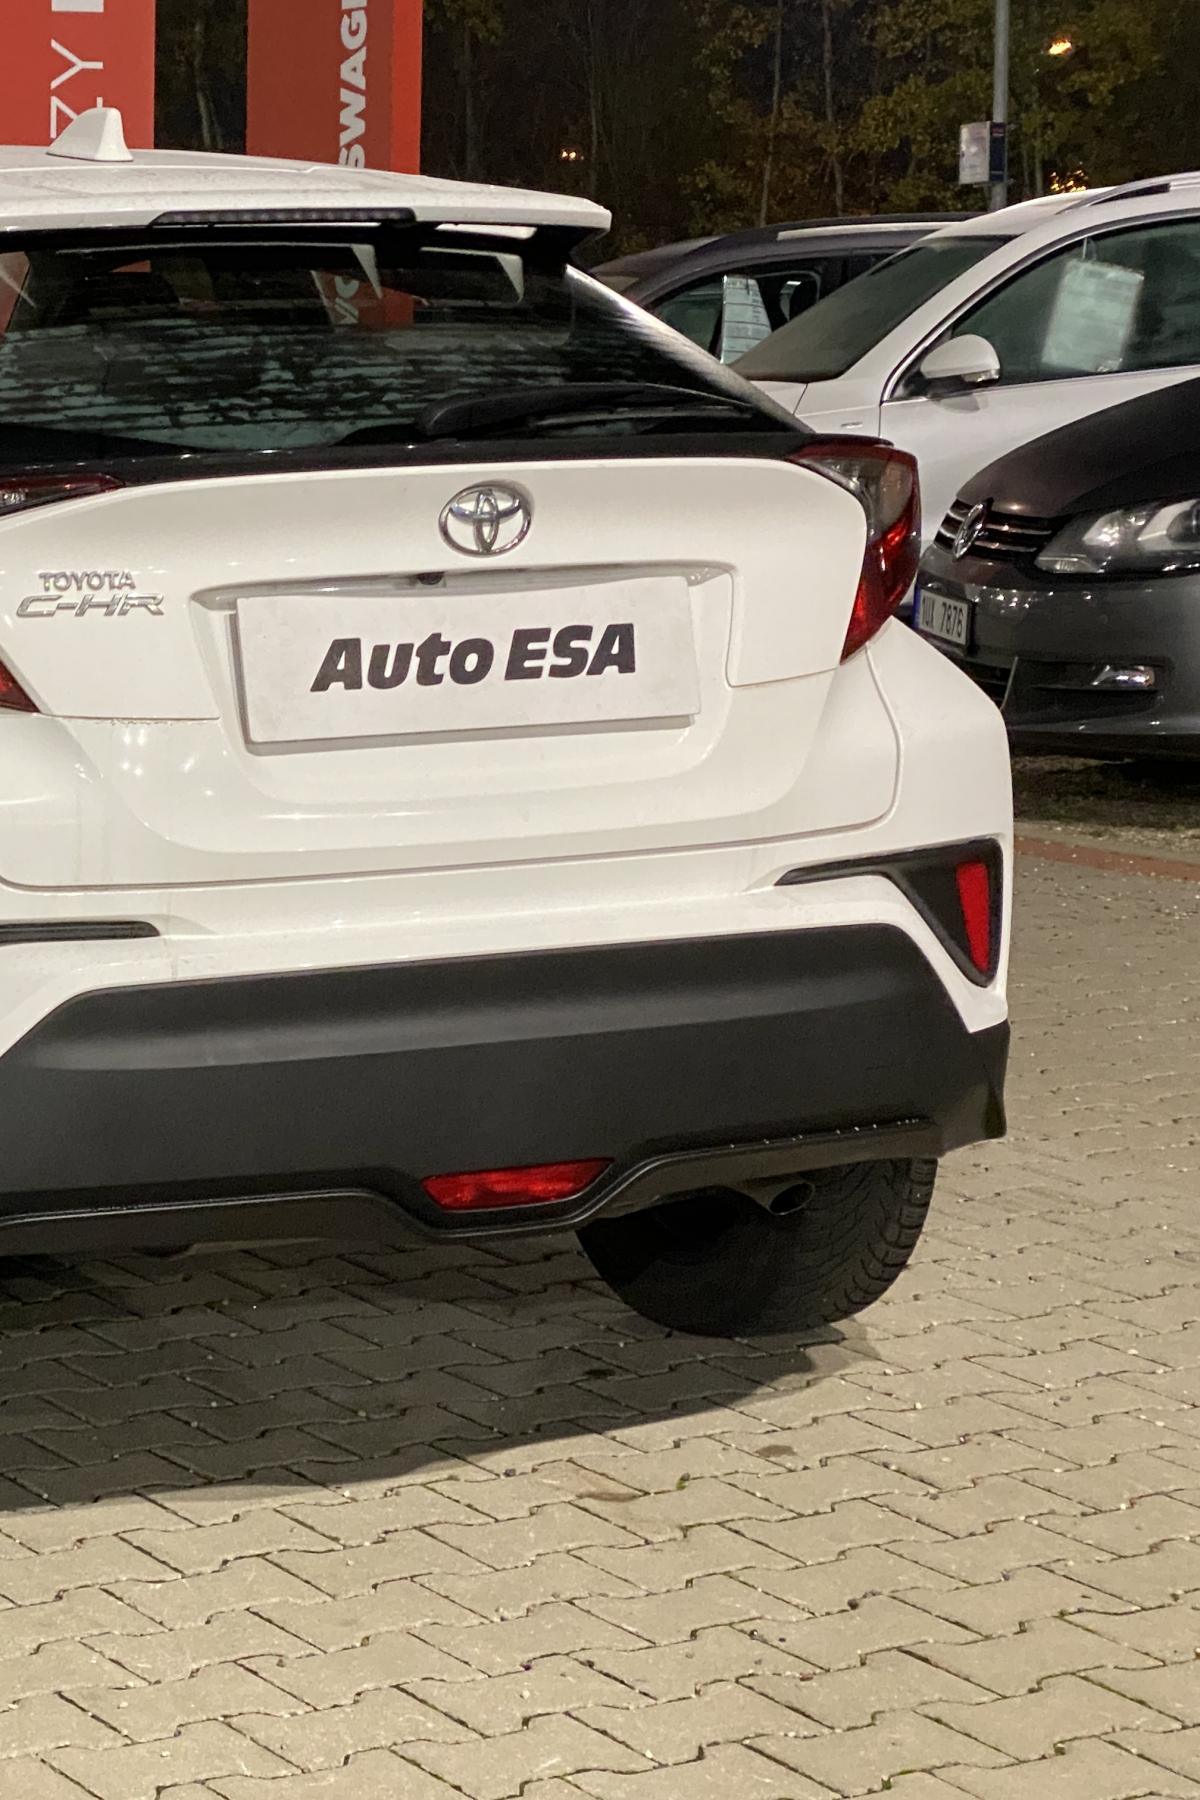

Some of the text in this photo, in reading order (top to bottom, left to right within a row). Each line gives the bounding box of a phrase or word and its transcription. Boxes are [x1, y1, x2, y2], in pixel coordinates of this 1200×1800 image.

[338, 0, 368, 168] SWAG
[38, 571, 136, 592] TOYOTA
[16, 593, 165, 618] C-HR
[940, 601, 964, 638] 7876
[309, 622, 636, 692] Auto ESA
